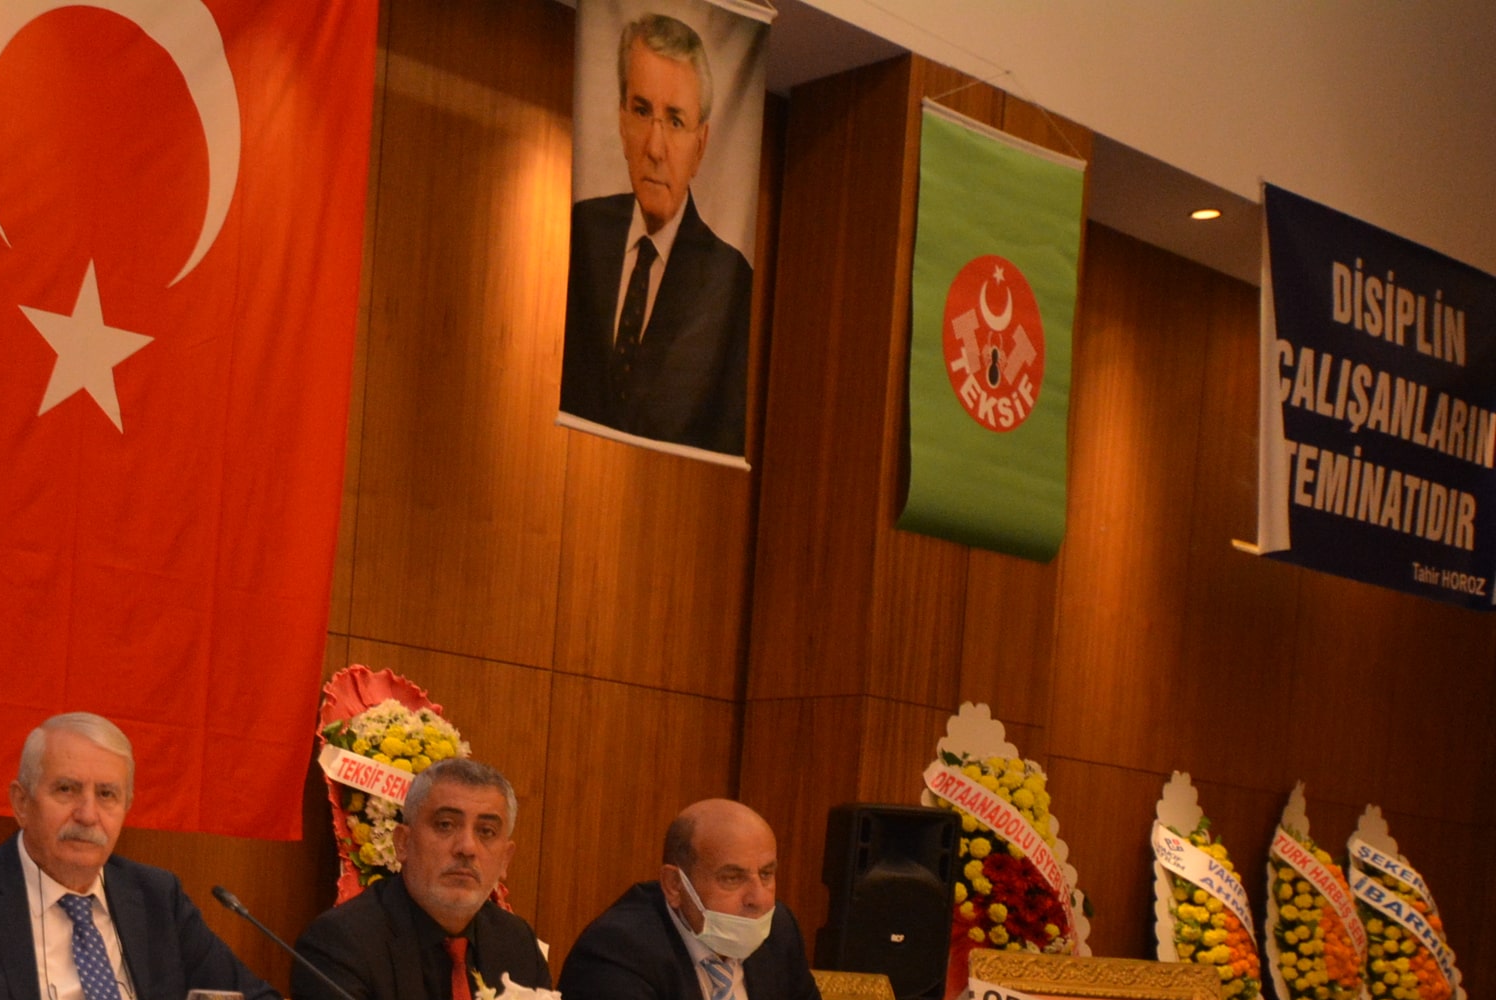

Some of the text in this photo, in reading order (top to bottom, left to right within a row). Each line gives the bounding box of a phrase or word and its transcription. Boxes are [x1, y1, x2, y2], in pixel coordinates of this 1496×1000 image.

[1331, 257, 1467, 367] DİSİPLİN
[1441, 568, 1487, 597] HOROZ
[337, 757, 385, 790] TEKSİF
[932, 771, 1035, 850] ORTAANADOLU
